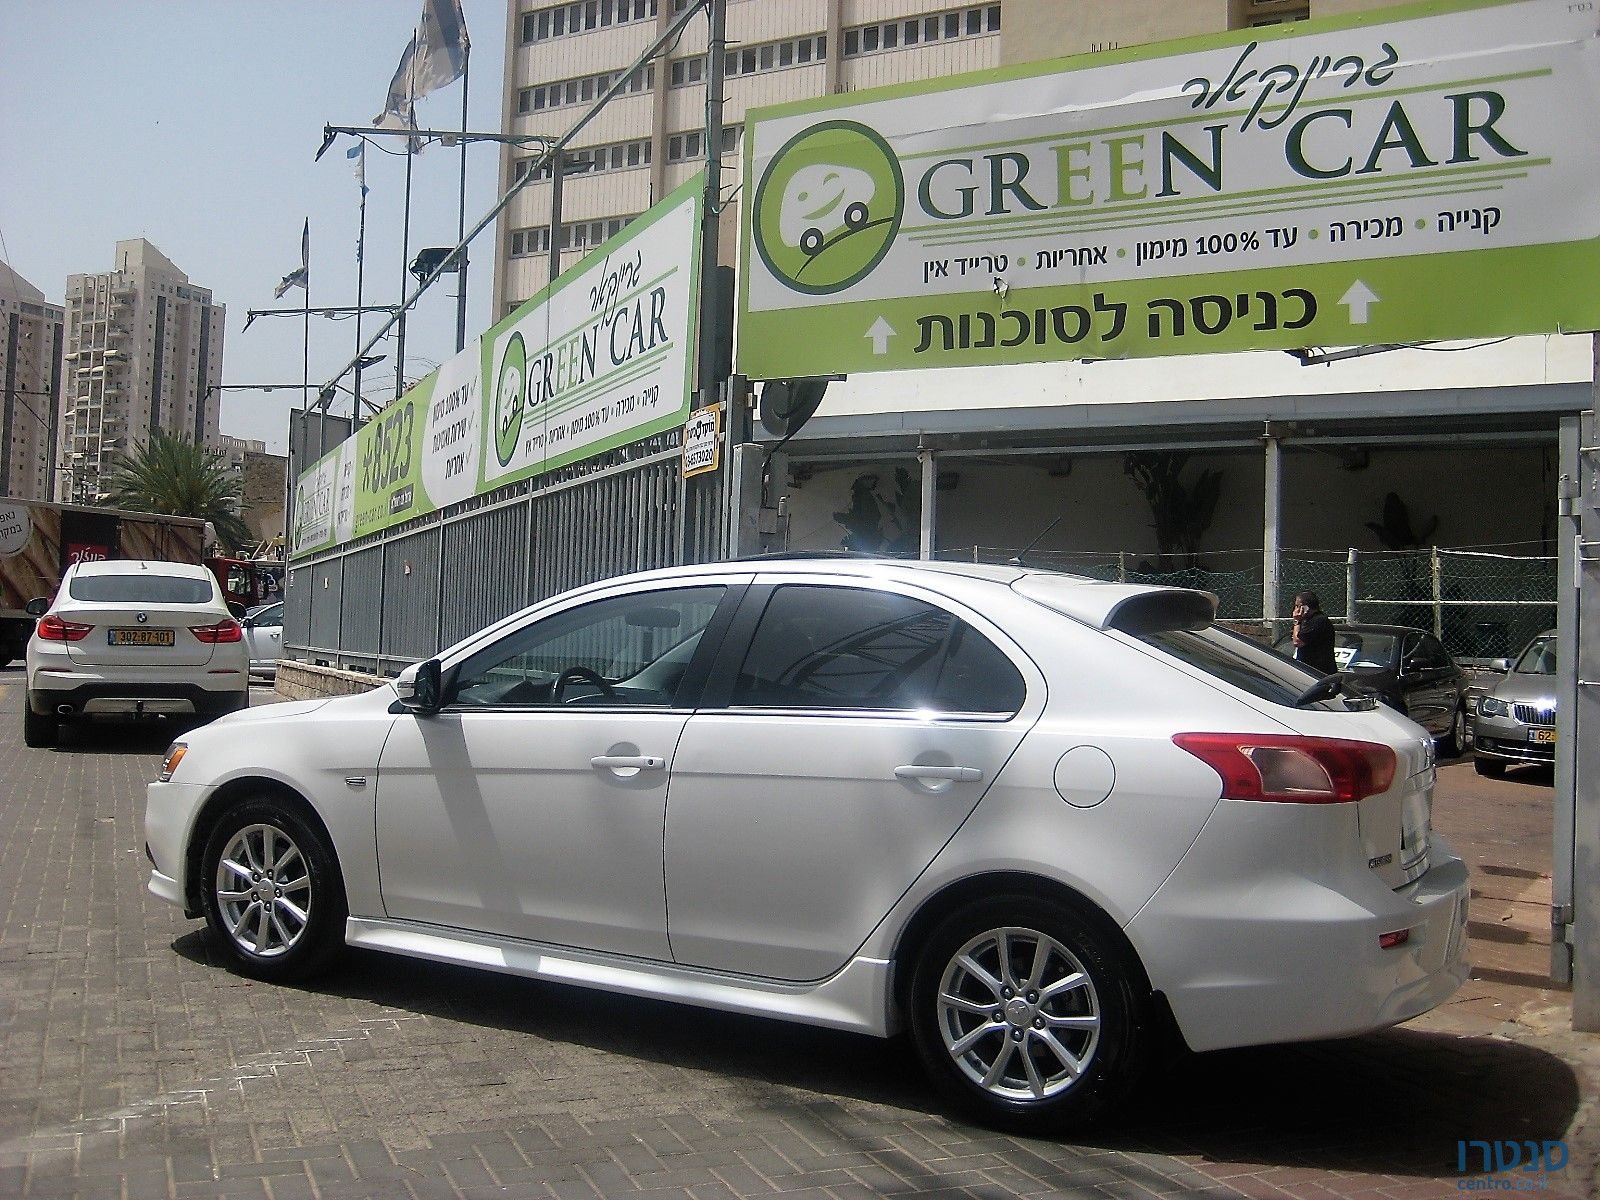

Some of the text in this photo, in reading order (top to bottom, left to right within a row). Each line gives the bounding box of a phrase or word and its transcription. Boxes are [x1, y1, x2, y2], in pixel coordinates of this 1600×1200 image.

[917, 90, 1530, 220] GREEN CAR
[923, 207, 1501, 283] קנייה מכירה עד 100% מימון אחריות טרייד אין
[527, 286, 669, 408] GREEN CAR
[913, 287, 1318, 353] כניסה לסוכנות
[0, 511, 16, 523] נאפ
